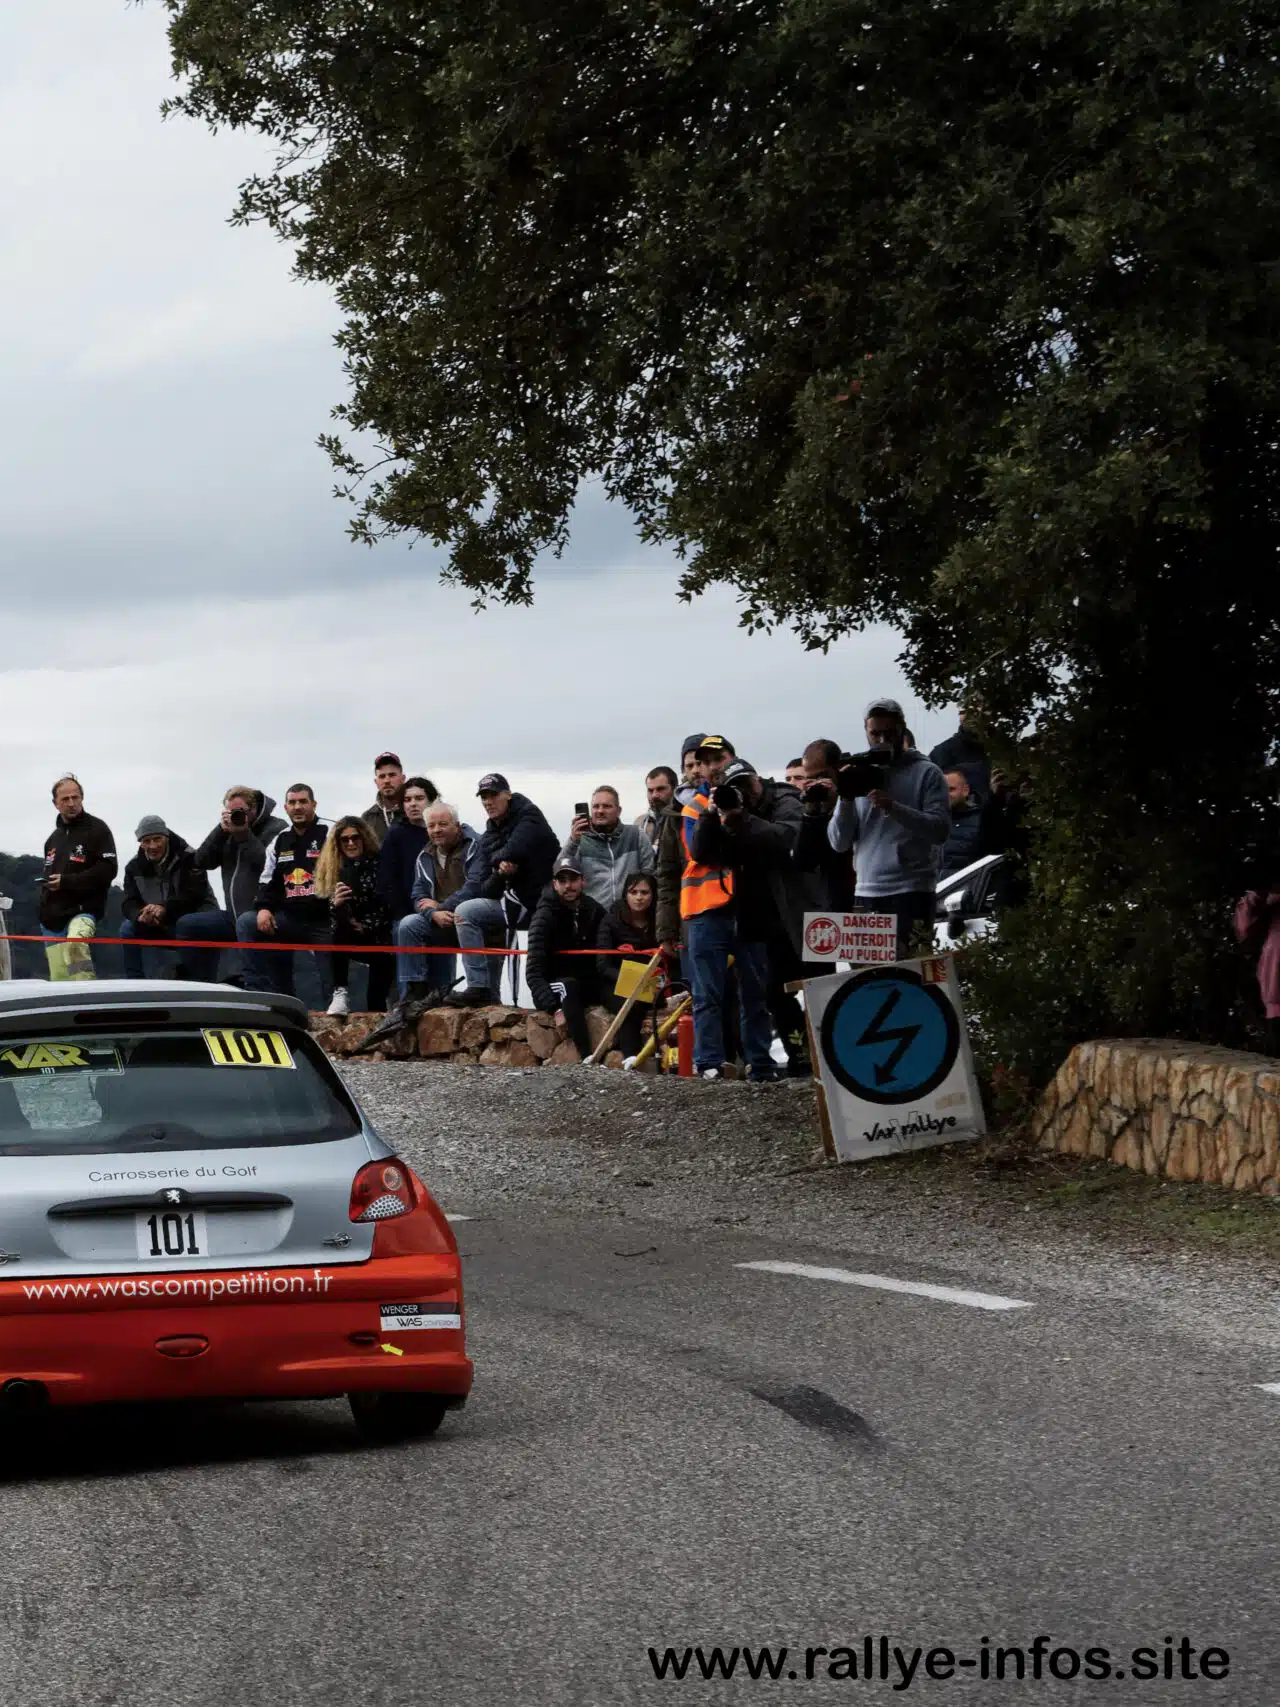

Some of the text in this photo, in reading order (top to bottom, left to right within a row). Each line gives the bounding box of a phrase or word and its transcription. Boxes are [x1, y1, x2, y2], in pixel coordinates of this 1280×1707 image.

[842, 915, 892, 929] DANGER
[840, 932, 896, 948] INTERDIT
[838, 949, 896, 962] AU PUBLIC
[209, 1030, 282, 1065] 101
[0, 1043, 90, 1070] VAR
[40, 1067, 55, 1075] 101
[88, 1165, 259, 1183] Carrosserie du Golf
[147, 1212, 200, 1256] 101
[22, 1269, 334, 1301] www.wascompetition.fr
[381, 1304, 419, 1315] WENGER
[396, 1317, 423, 1328] WAS
